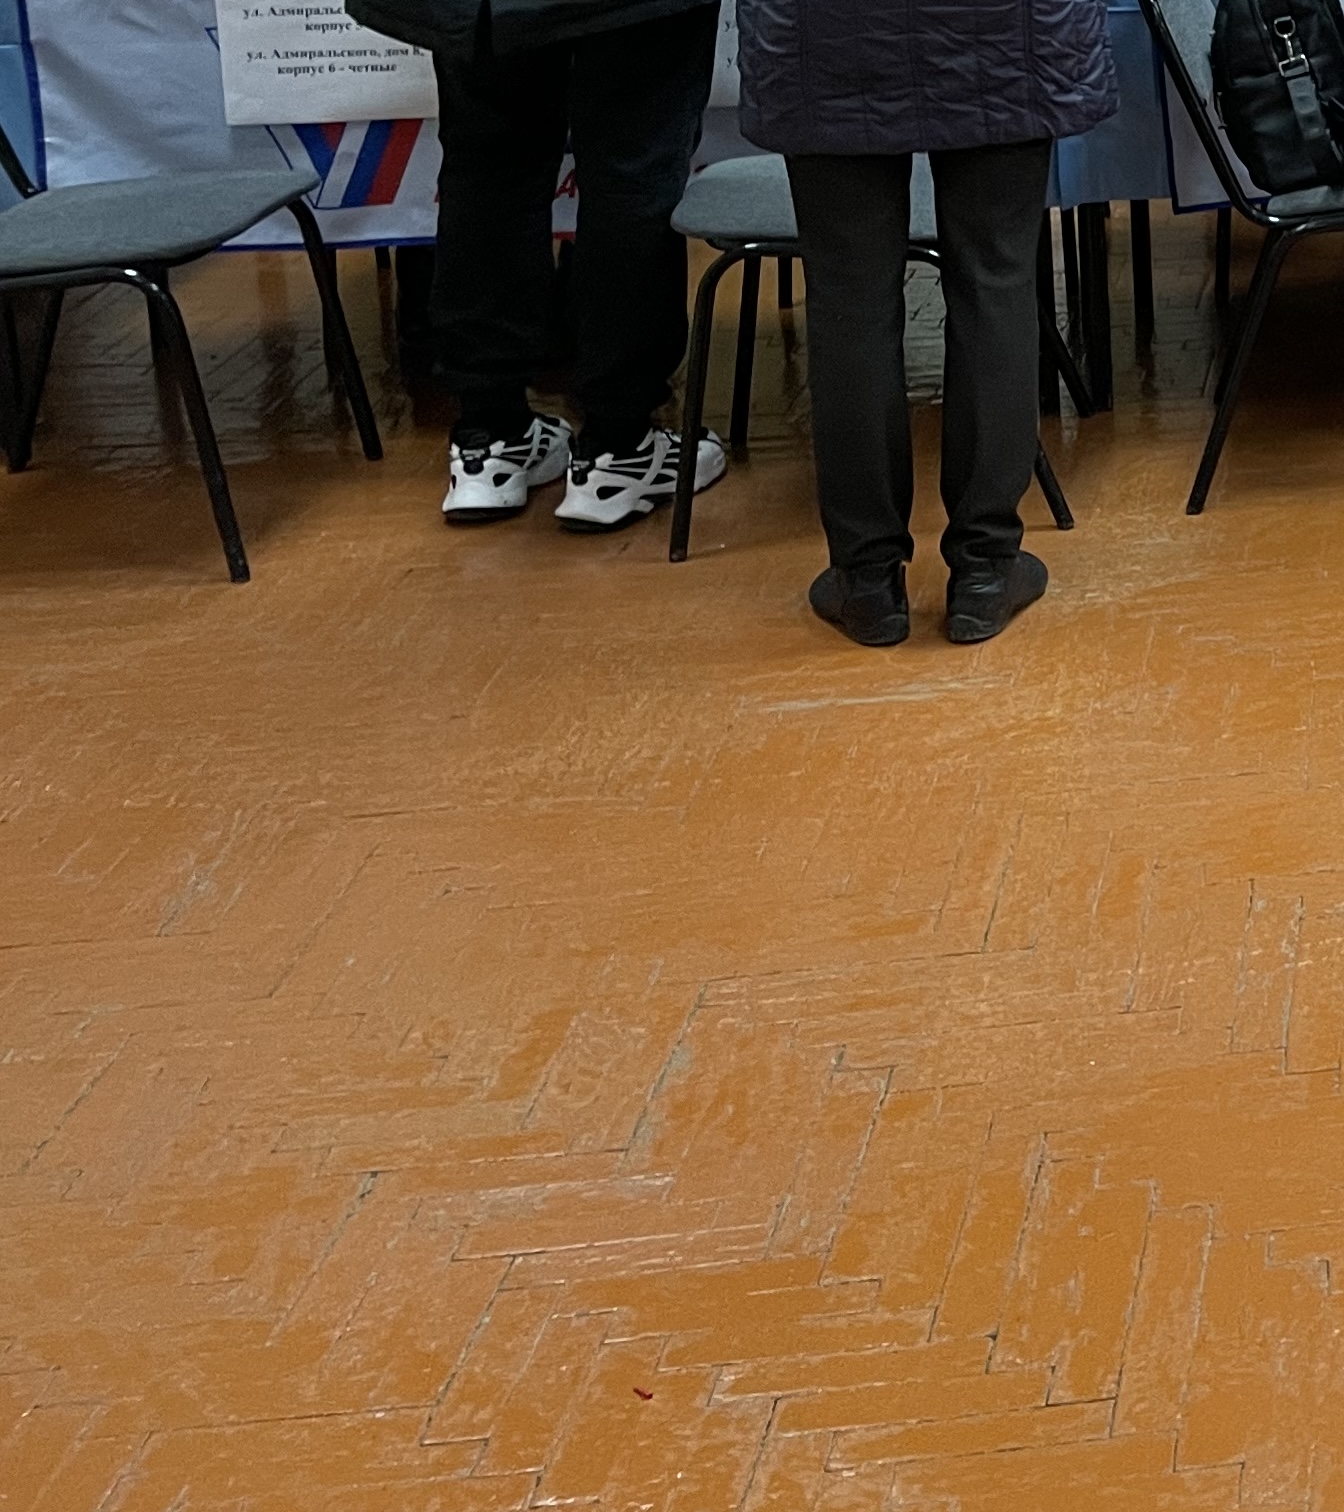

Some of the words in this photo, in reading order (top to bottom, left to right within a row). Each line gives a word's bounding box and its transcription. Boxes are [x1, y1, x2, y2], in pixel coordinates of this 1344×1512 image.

[268, 6, 344, 18] Адмиральс
[305, 22, 353, 34] корпус
[384, 49, 409, 58] дом
[277, 64, 325, 78] корпус
[328, 63, 336, 74] 6
[348, 63, 398, 73] четные
